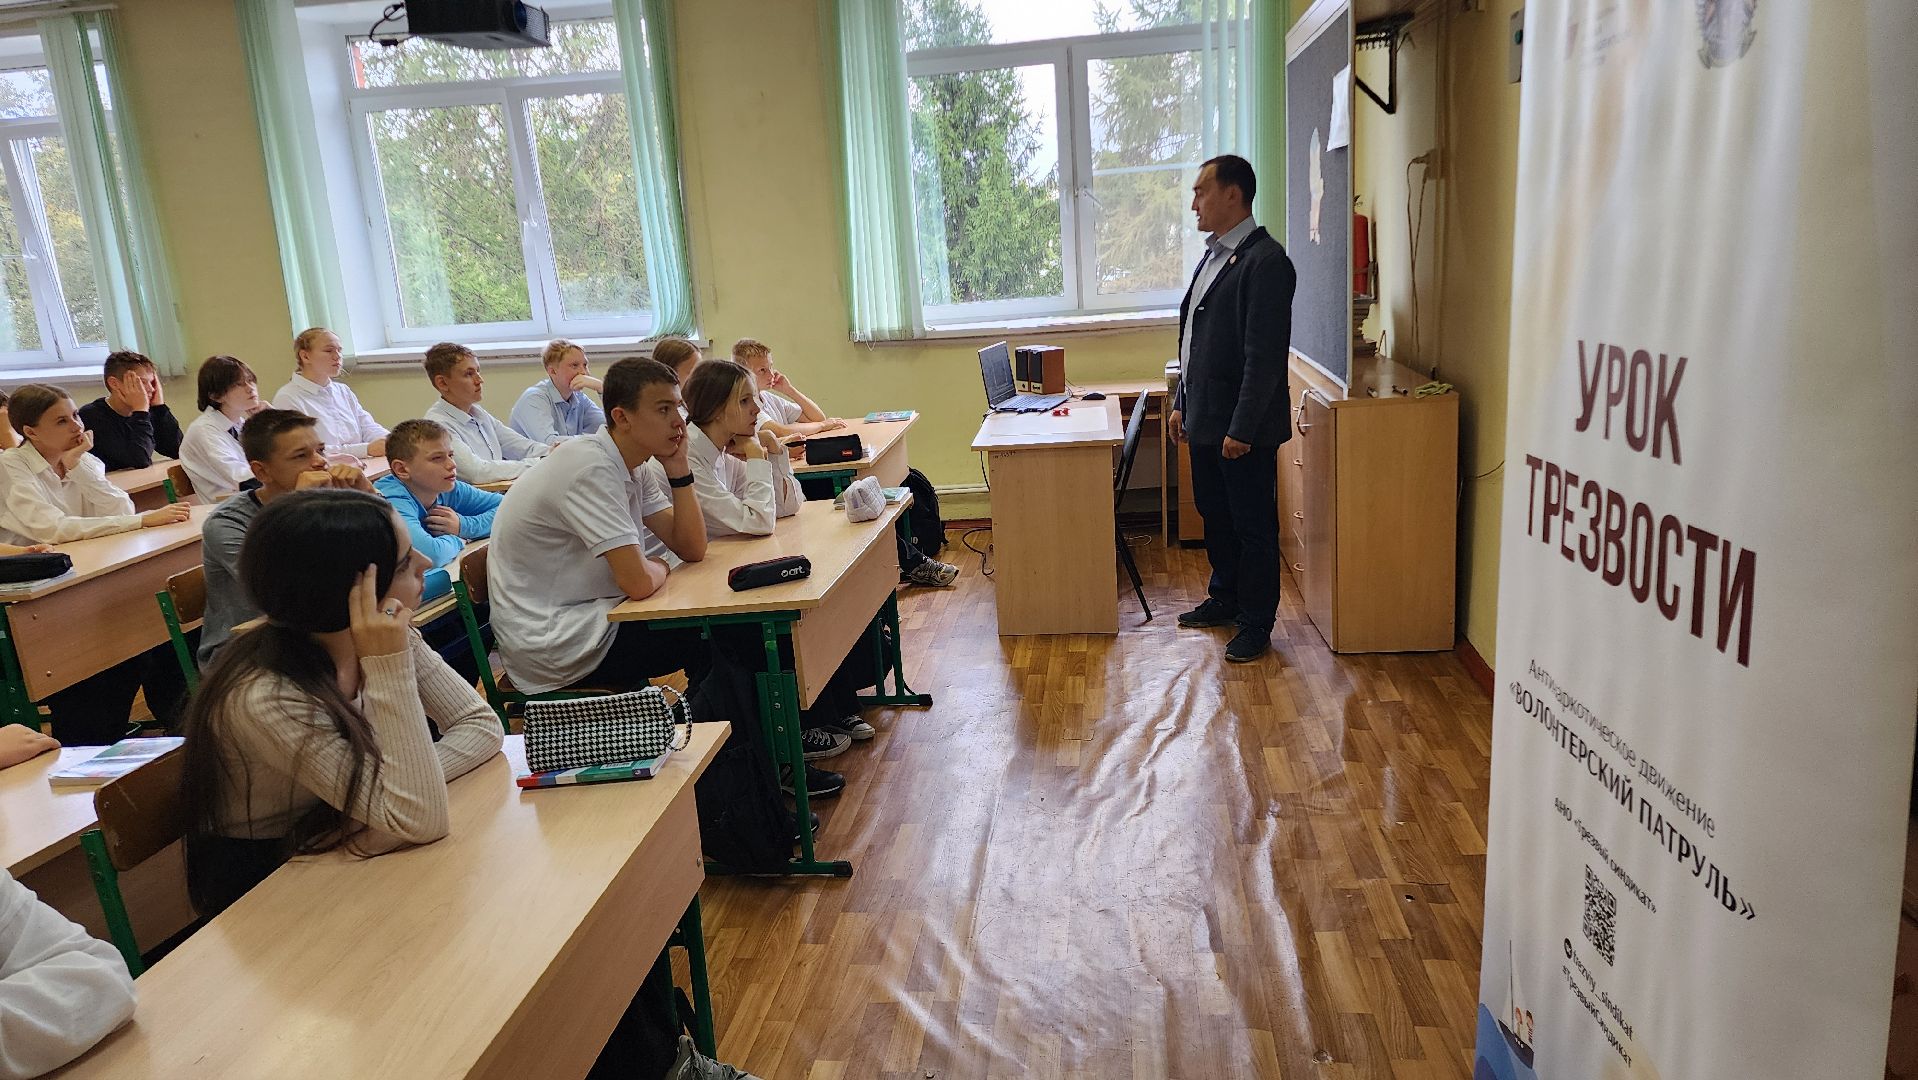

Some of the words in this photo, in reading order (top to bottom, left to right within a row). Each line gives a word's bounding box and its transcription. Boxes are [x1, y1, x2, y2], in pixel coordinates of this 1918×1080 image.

[1575, 340, 1688, 465] УРОК
[1526, 454, 1757, 668] ТРЕЗВОСТИ
[1509, 681, 1634, 813] «ВОЛОНТЕРСКИЙ
[1639, 796, 1756, 921] ПАТРУЛЬ»
[1529, 659, 1637, 768] Антинаркотическое
[1638, 759, 1716, 838] движение
